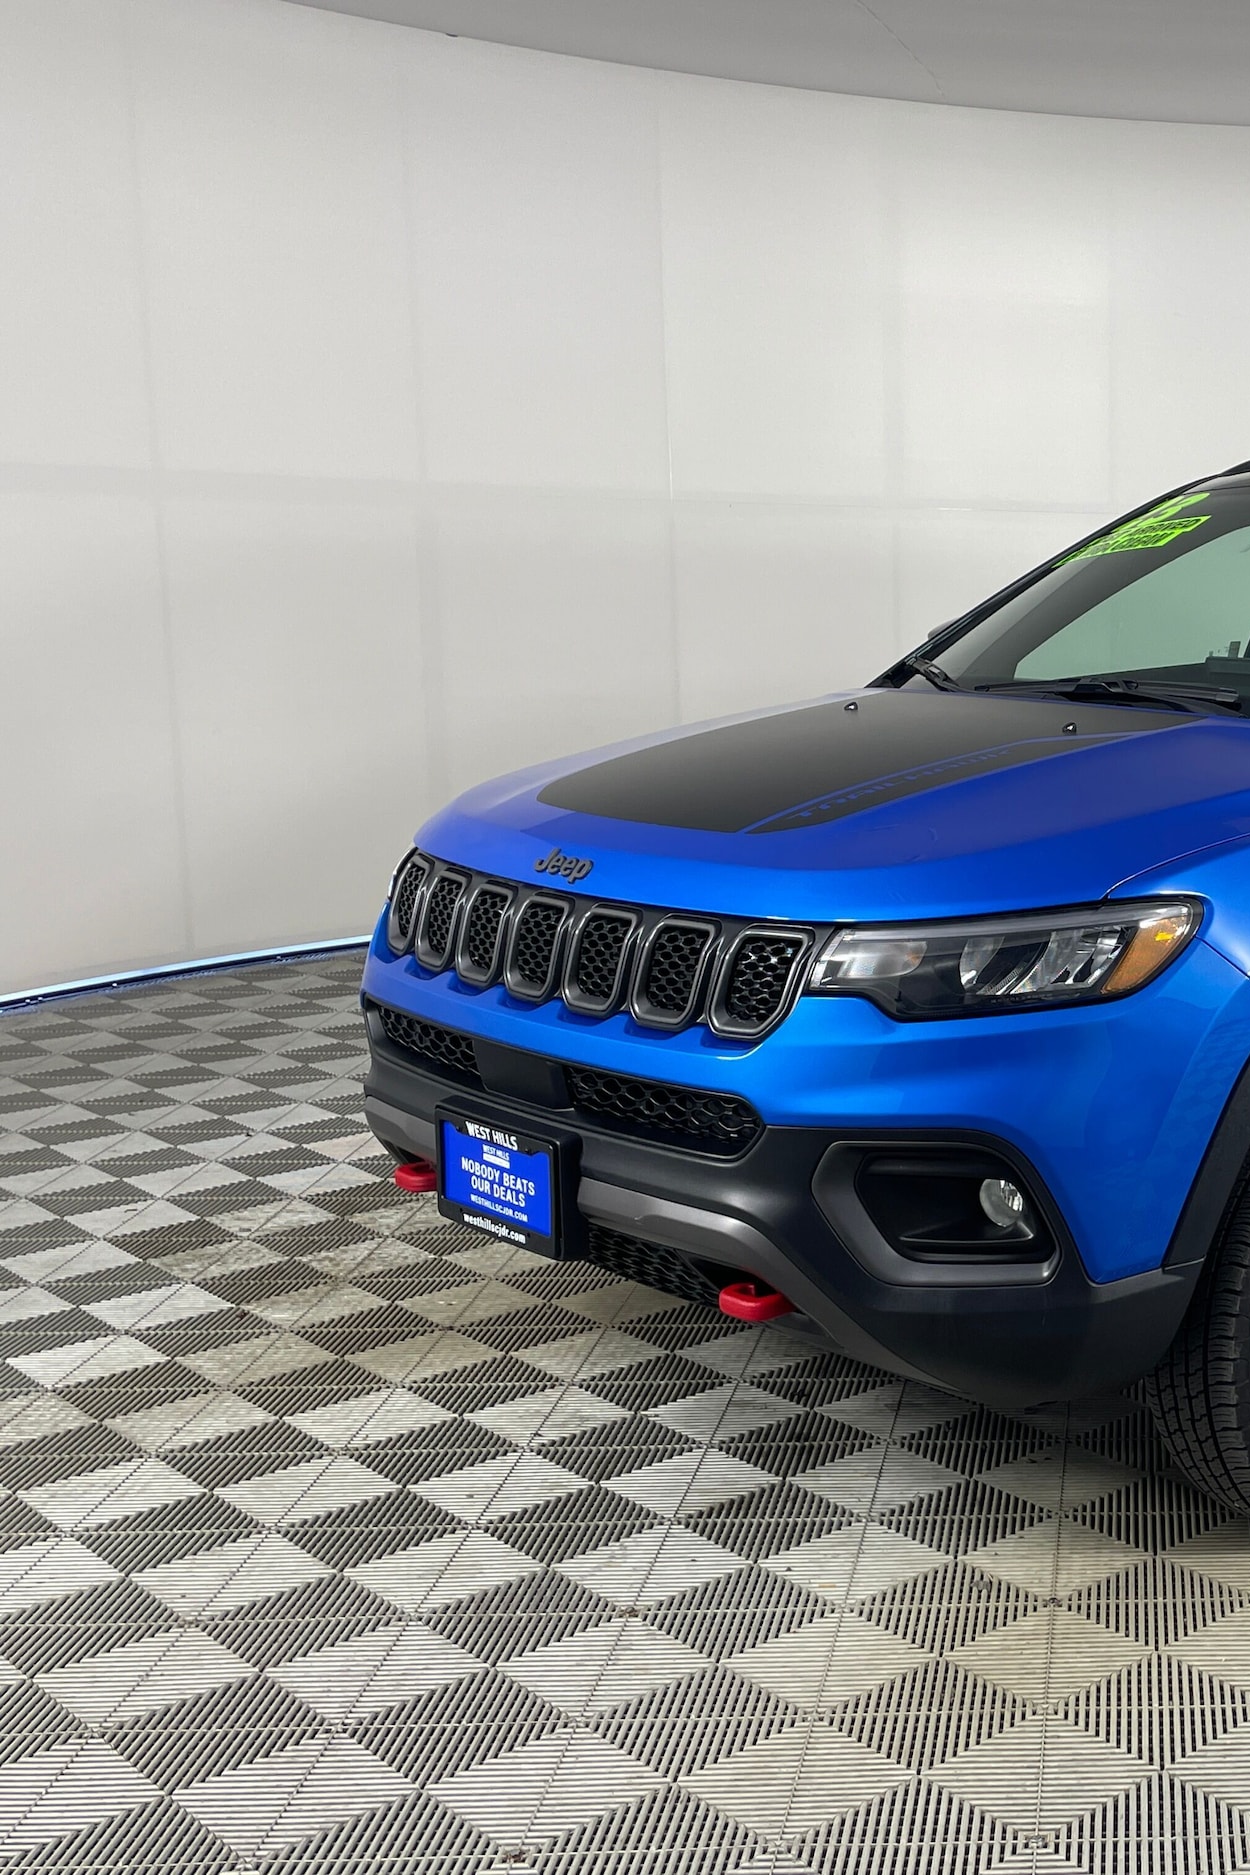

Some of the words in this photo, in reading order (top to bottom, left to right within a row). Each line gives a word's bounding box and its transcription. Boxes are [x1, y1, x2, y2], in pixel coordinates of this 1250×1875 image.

[534, 847, 594, 885] Jeep
[465, 1121, 491, 1143] WEST
[493, 1130, 518, 1151] HILLS
[482, 1144, 496, 1155] WEST
[496, 1149, 510, 1161] HILLS
[461, 1156, 500, 1182] NOBODY
[503, 1168, 535, 1196] BEATS
[471, 1175, 491, 1195] OUR
[493, 1183, 525, 1208] DEALS
[470, 1194, 528, 1223] WESTHILLSCJDR.COM
[463, 1213, 526, 1244] westhillscjdr.com
